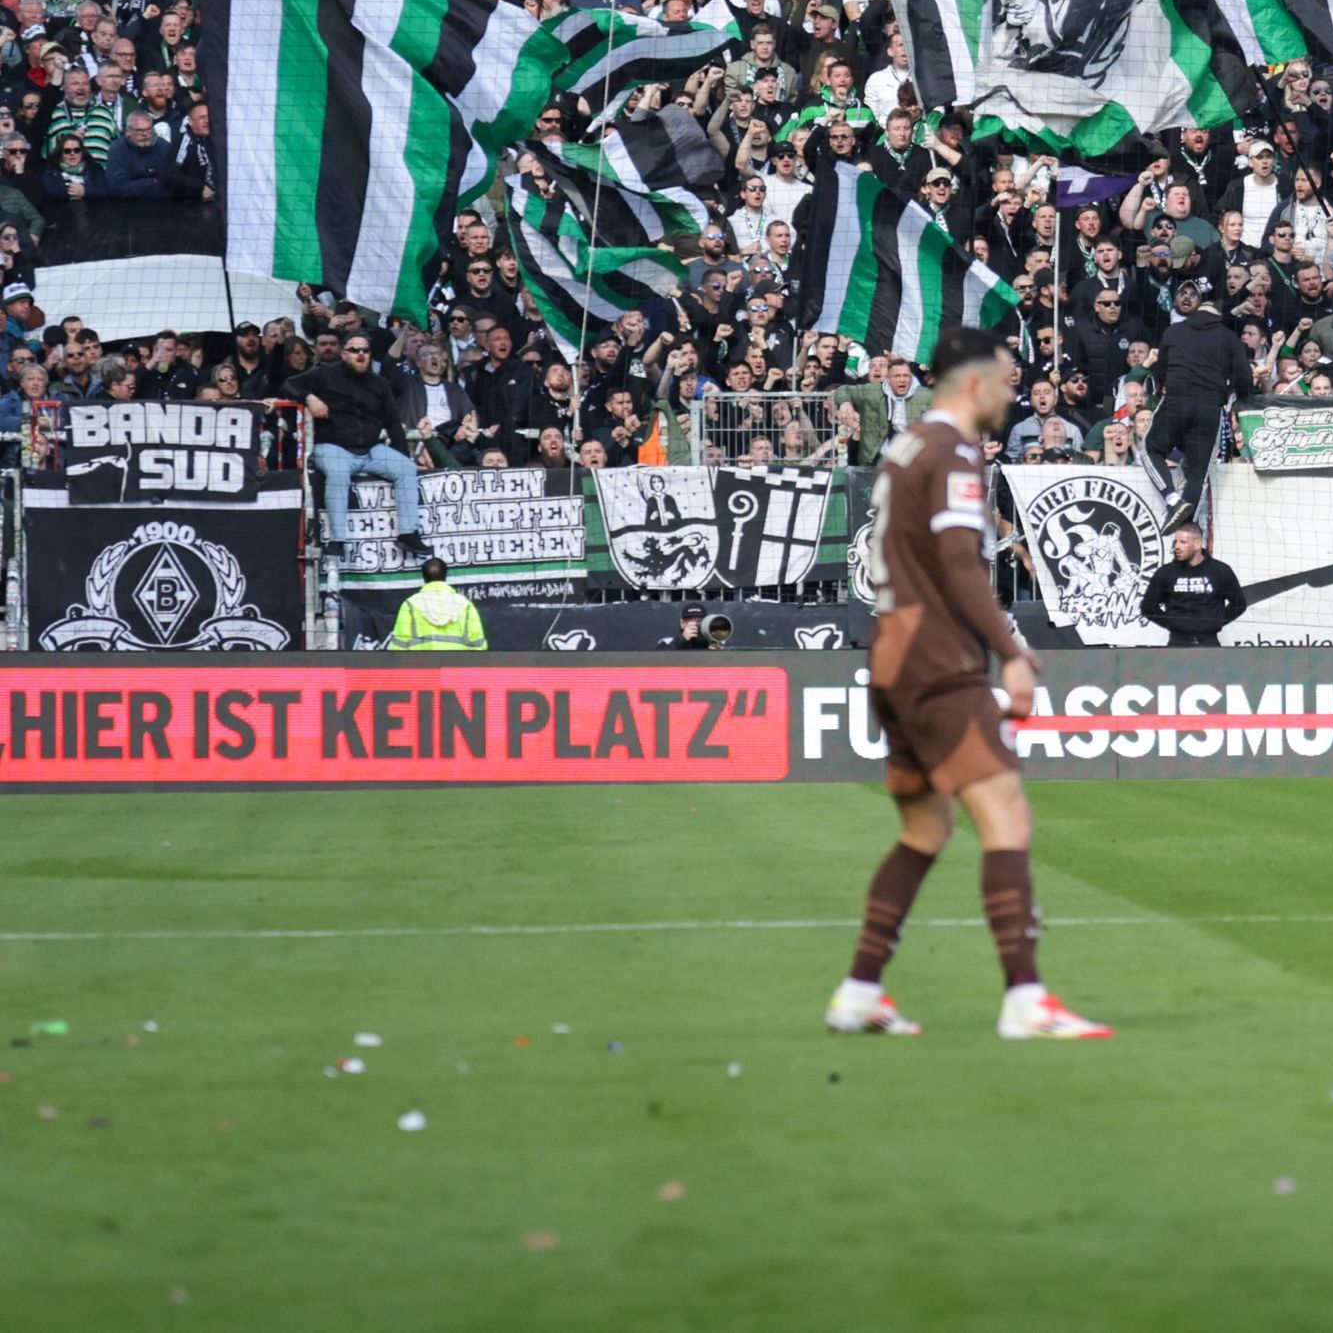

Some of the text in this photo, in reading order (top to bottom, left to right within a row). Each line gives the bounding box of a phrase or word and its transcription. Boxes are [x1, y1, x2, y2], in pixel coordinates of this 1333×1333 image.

[69, 403, 253, 450] BANDA
[139, 449, 245, 493] SUD
[419, 468, 546, 506] WOLLEN
[355, 482, 396, 510] WI
[1030, 482, 1077, 534] AHRE
[132, 521, 197, 545] 1900
[193, 689, 302, 760] IST
[322, 689, 485, 760] KEIN
[803, 668, 889, 760] FÜ
